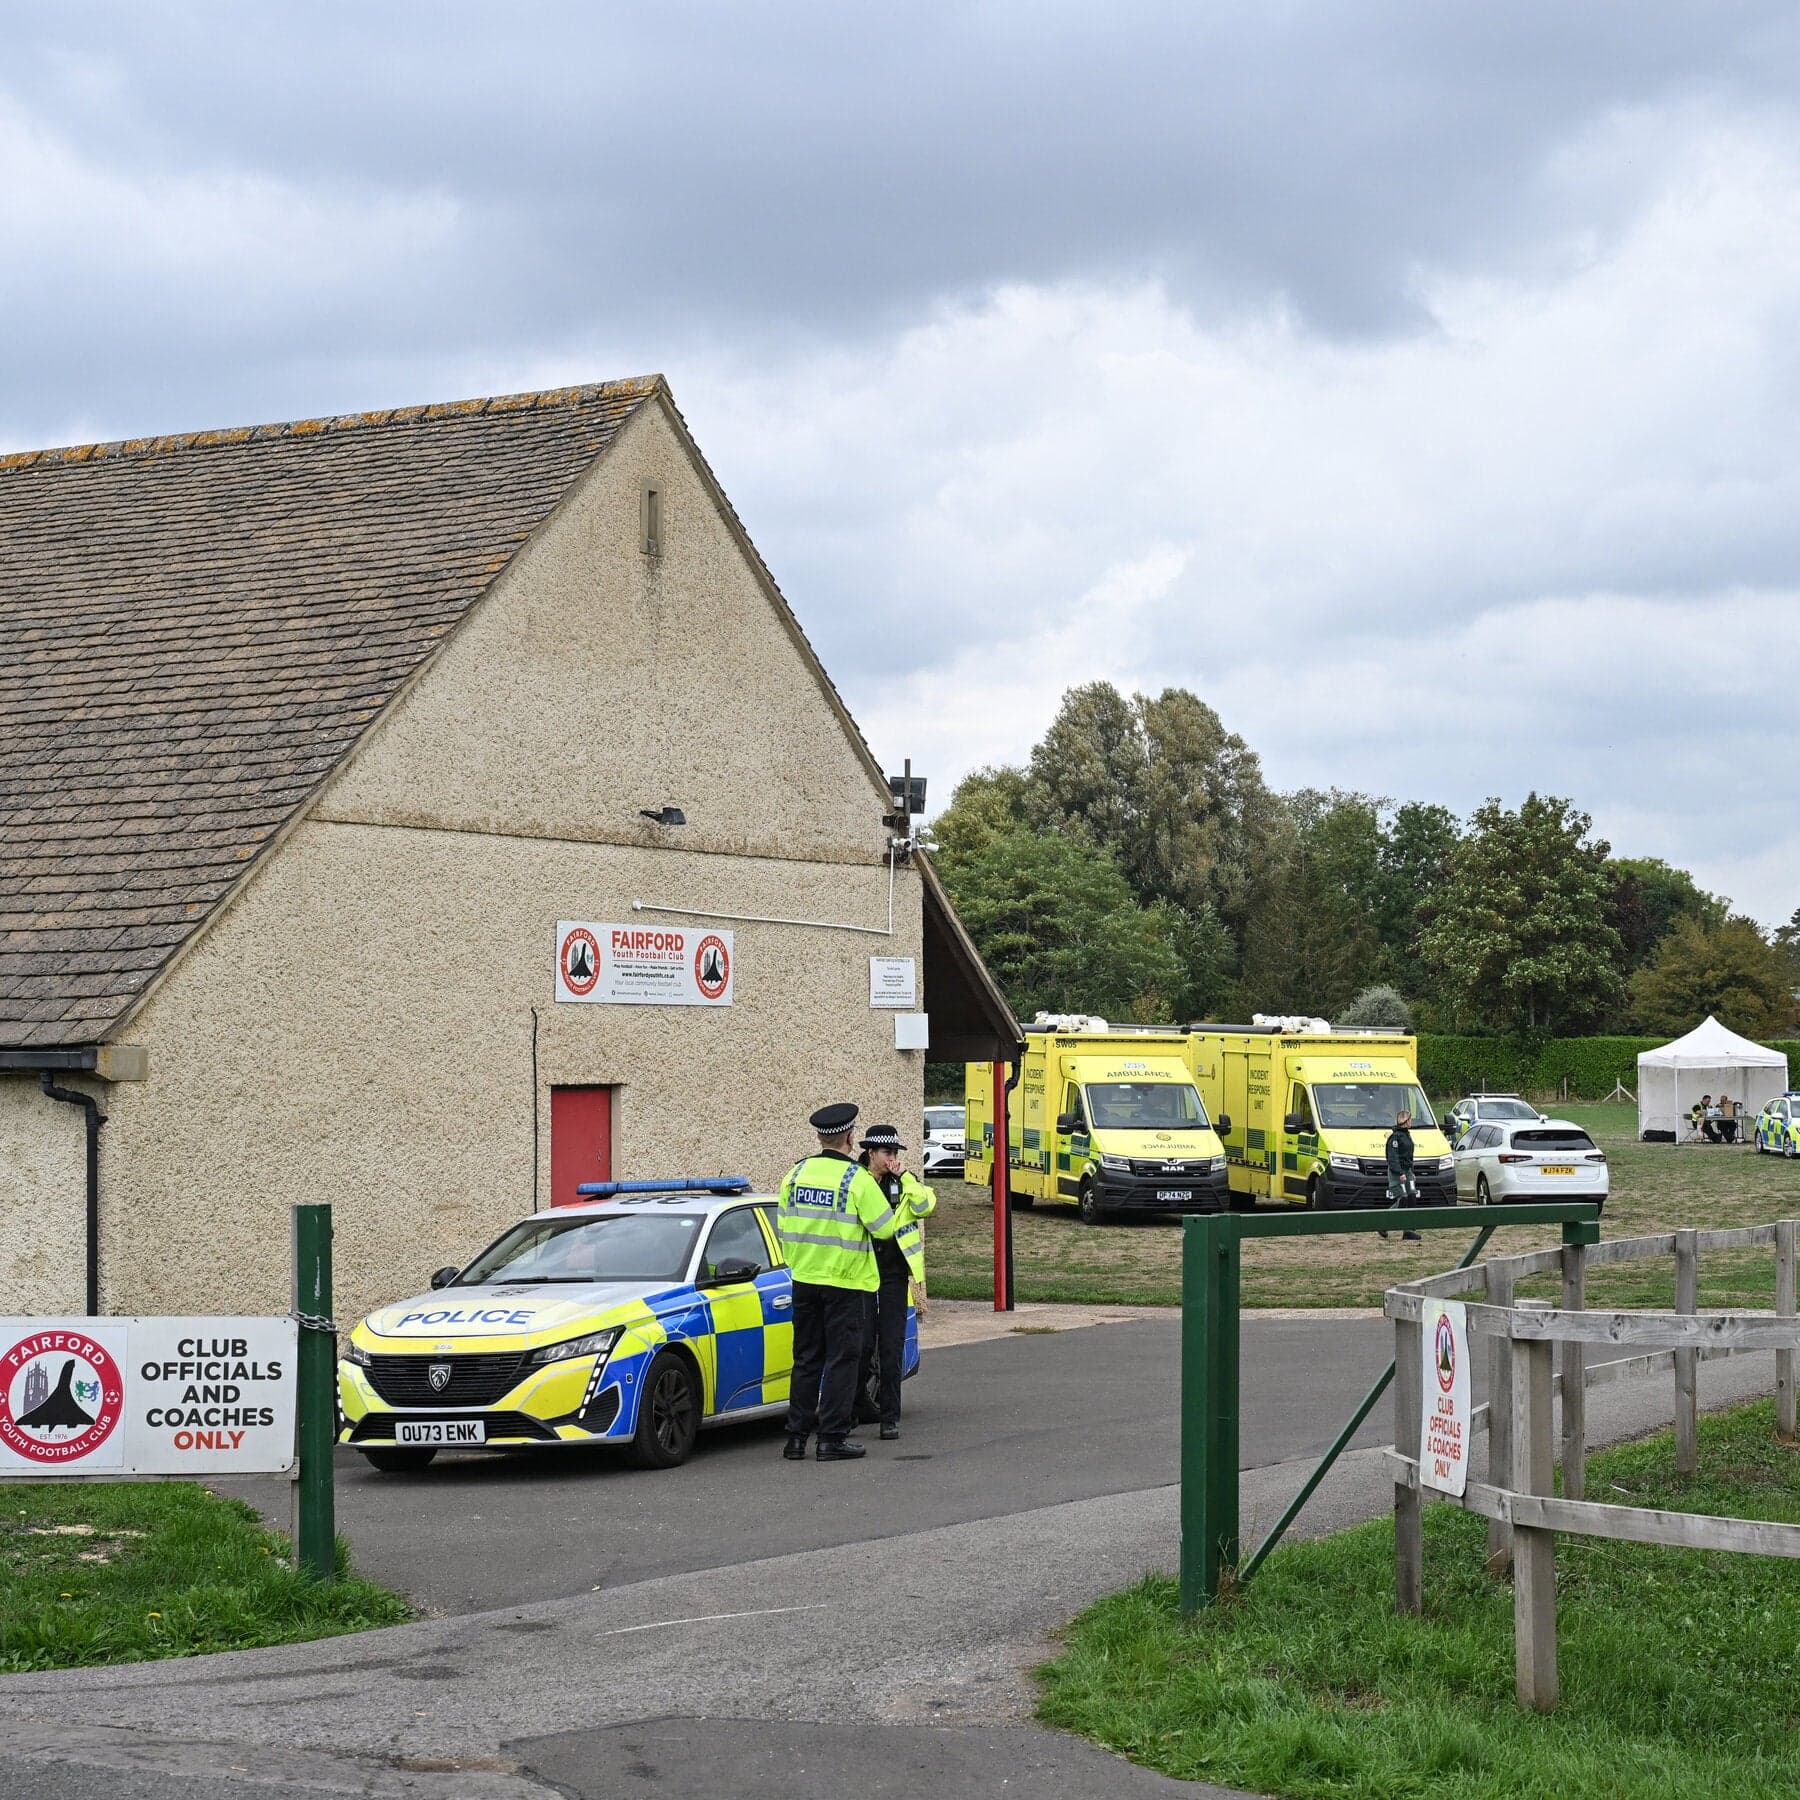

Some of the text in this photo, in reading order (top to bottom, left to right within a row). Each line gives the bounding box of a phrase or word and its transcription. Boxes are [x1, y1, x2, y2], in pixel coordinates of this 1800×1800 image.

[566, 930, 595, 945] FAIRFORD
[611, 930, 684, 951] FAIRFORD
[612, 950, 684, 961] Youth Football Club
[1055, 1039, 1077, 1049] SW05
[1106, 1070, 1172, 1078] AMBULANCE
[1332, 1071, 1398, 1079] AMBULANCE
[797, 1188, 833, 1205] POLICE
[396, 1309, 536, 1328] POLICE
[8, 1335, 105, 1366] FAIRFORD
[178, 1339, 248, 1358] CLUB
[141, 1361, 283, 1381] OFFICIALS
[181, 1385, 241, 1404] AND
[1437, 1396, 1454, 1416] CLUB
[146, 1408, 274, 1428] COACHES
[1430, 1415, 1461, 1439] OFFICIALS
[0, 1415, 111, 1456] YOUTH FOOTBALL CLUB
[174, 1431, 246, 1450] ONLY
[402, 1424, 478, 1441] OU73 ENK
[1427, 1435, 1461, 1460] & COACHES
[1434, 1458, 1450, 1478] ONLY
